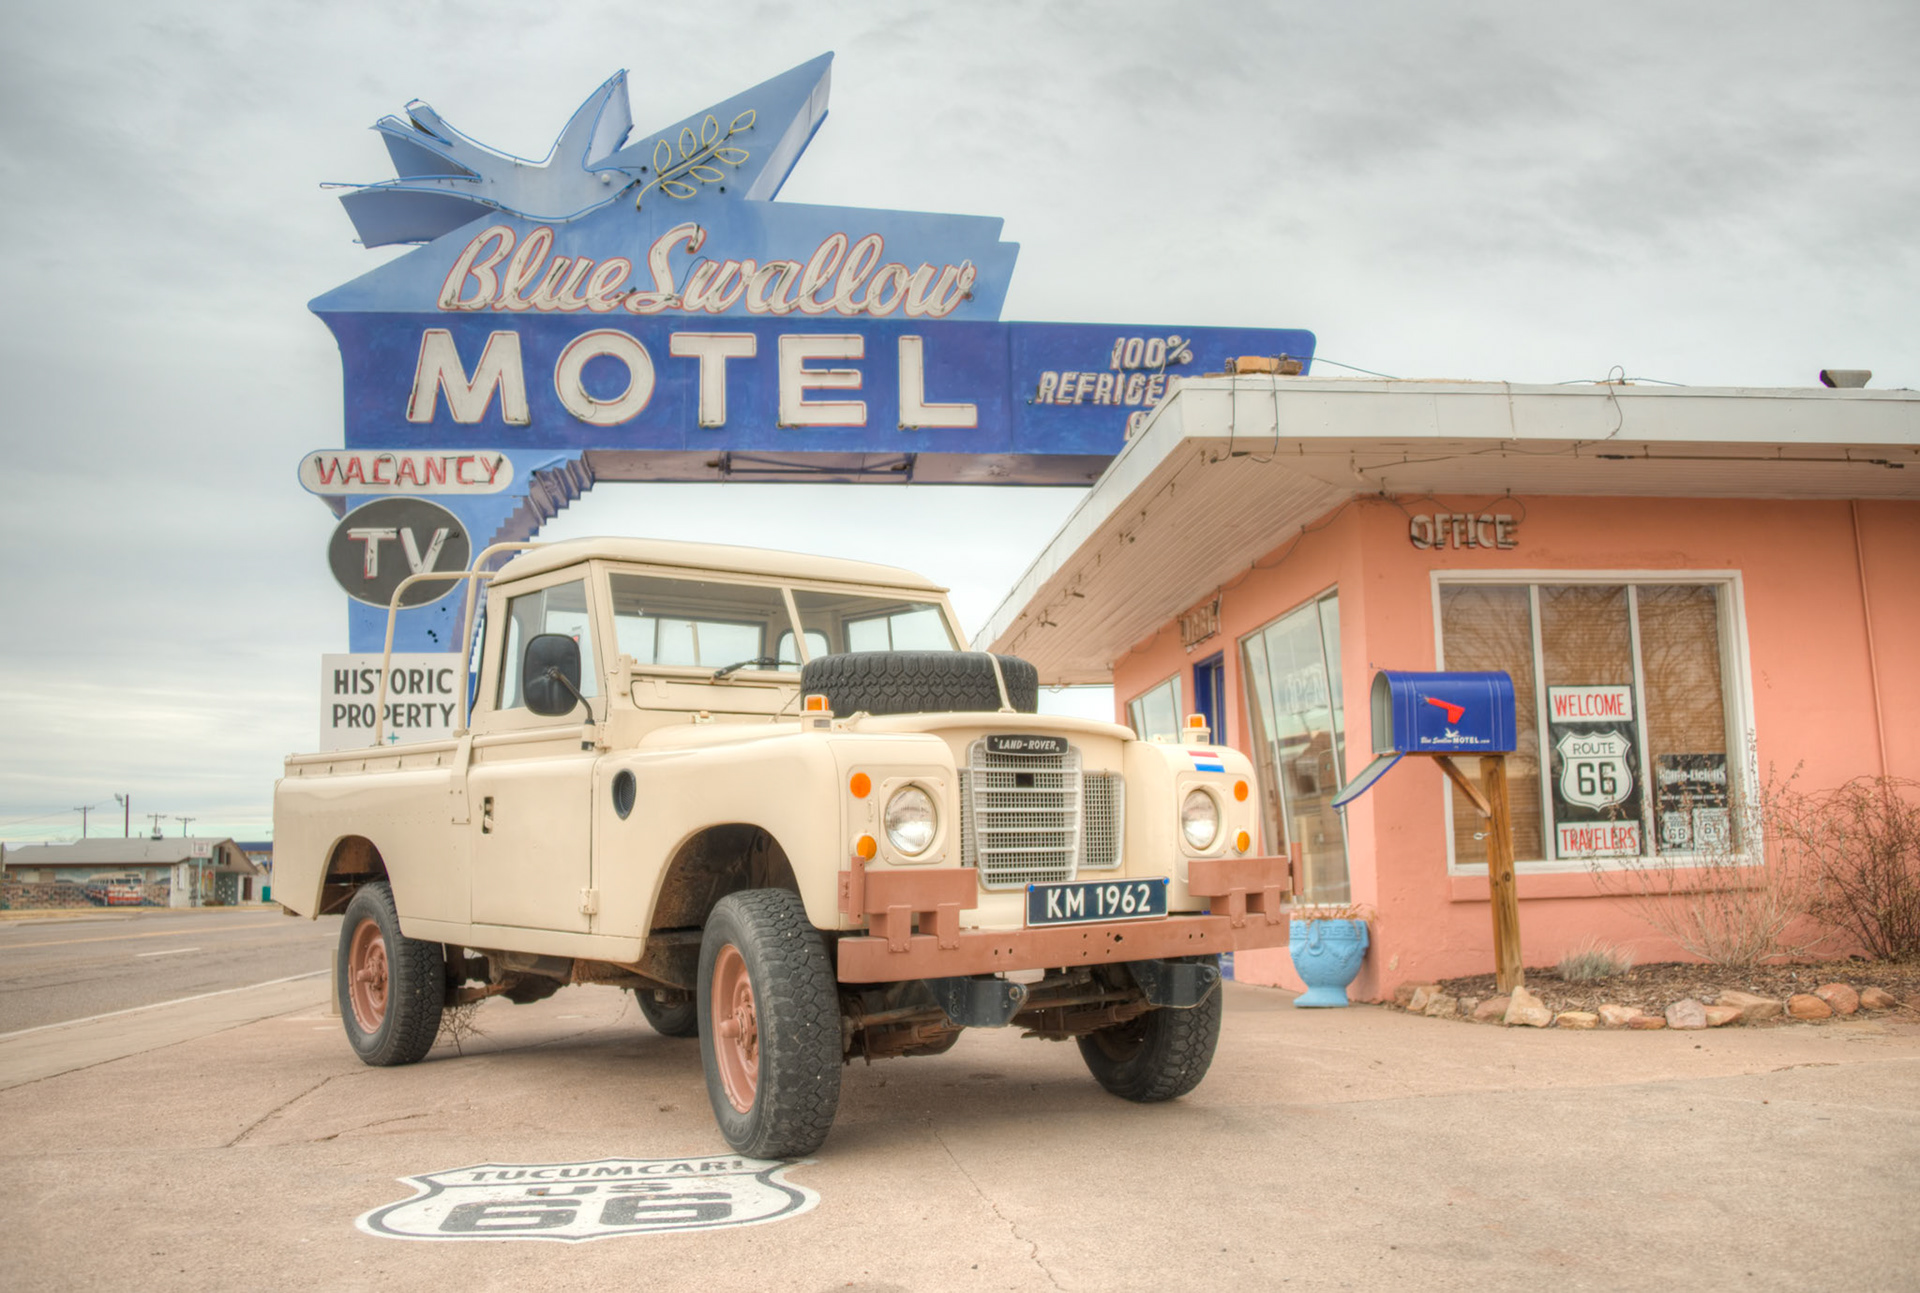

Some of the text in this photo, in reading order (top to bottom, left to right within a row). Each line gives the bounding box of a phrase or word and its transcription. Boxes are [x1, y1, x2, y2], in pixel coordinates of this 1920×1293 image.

[438, 222, 976, 315] Blue Swallow
[1110, 335, 1193, 369] 100%
[406, 329, 978, 428] MOTEL
[314, 455, 503, 486] VACANCY
[1409, 513, 1519, 550] OFFICE
[347, 527, 450, 579] TV
[1554, 694, 1626, 716] WELCOME
[998, 739, 1057, 751] LAND-ROVER
[1573, 742, 1616, 755] ROUTE
[1577, 761, 1617, 796] 66
[1561, 827, 1637, 852] TRAVELERS
[1047, 884, 1151, 919] KM 1962
[469, 1160, 744, 1182] TUCUMCARI
[525, 1182, 673, 1196] US
[438, 1192, 733, 1232] 66
